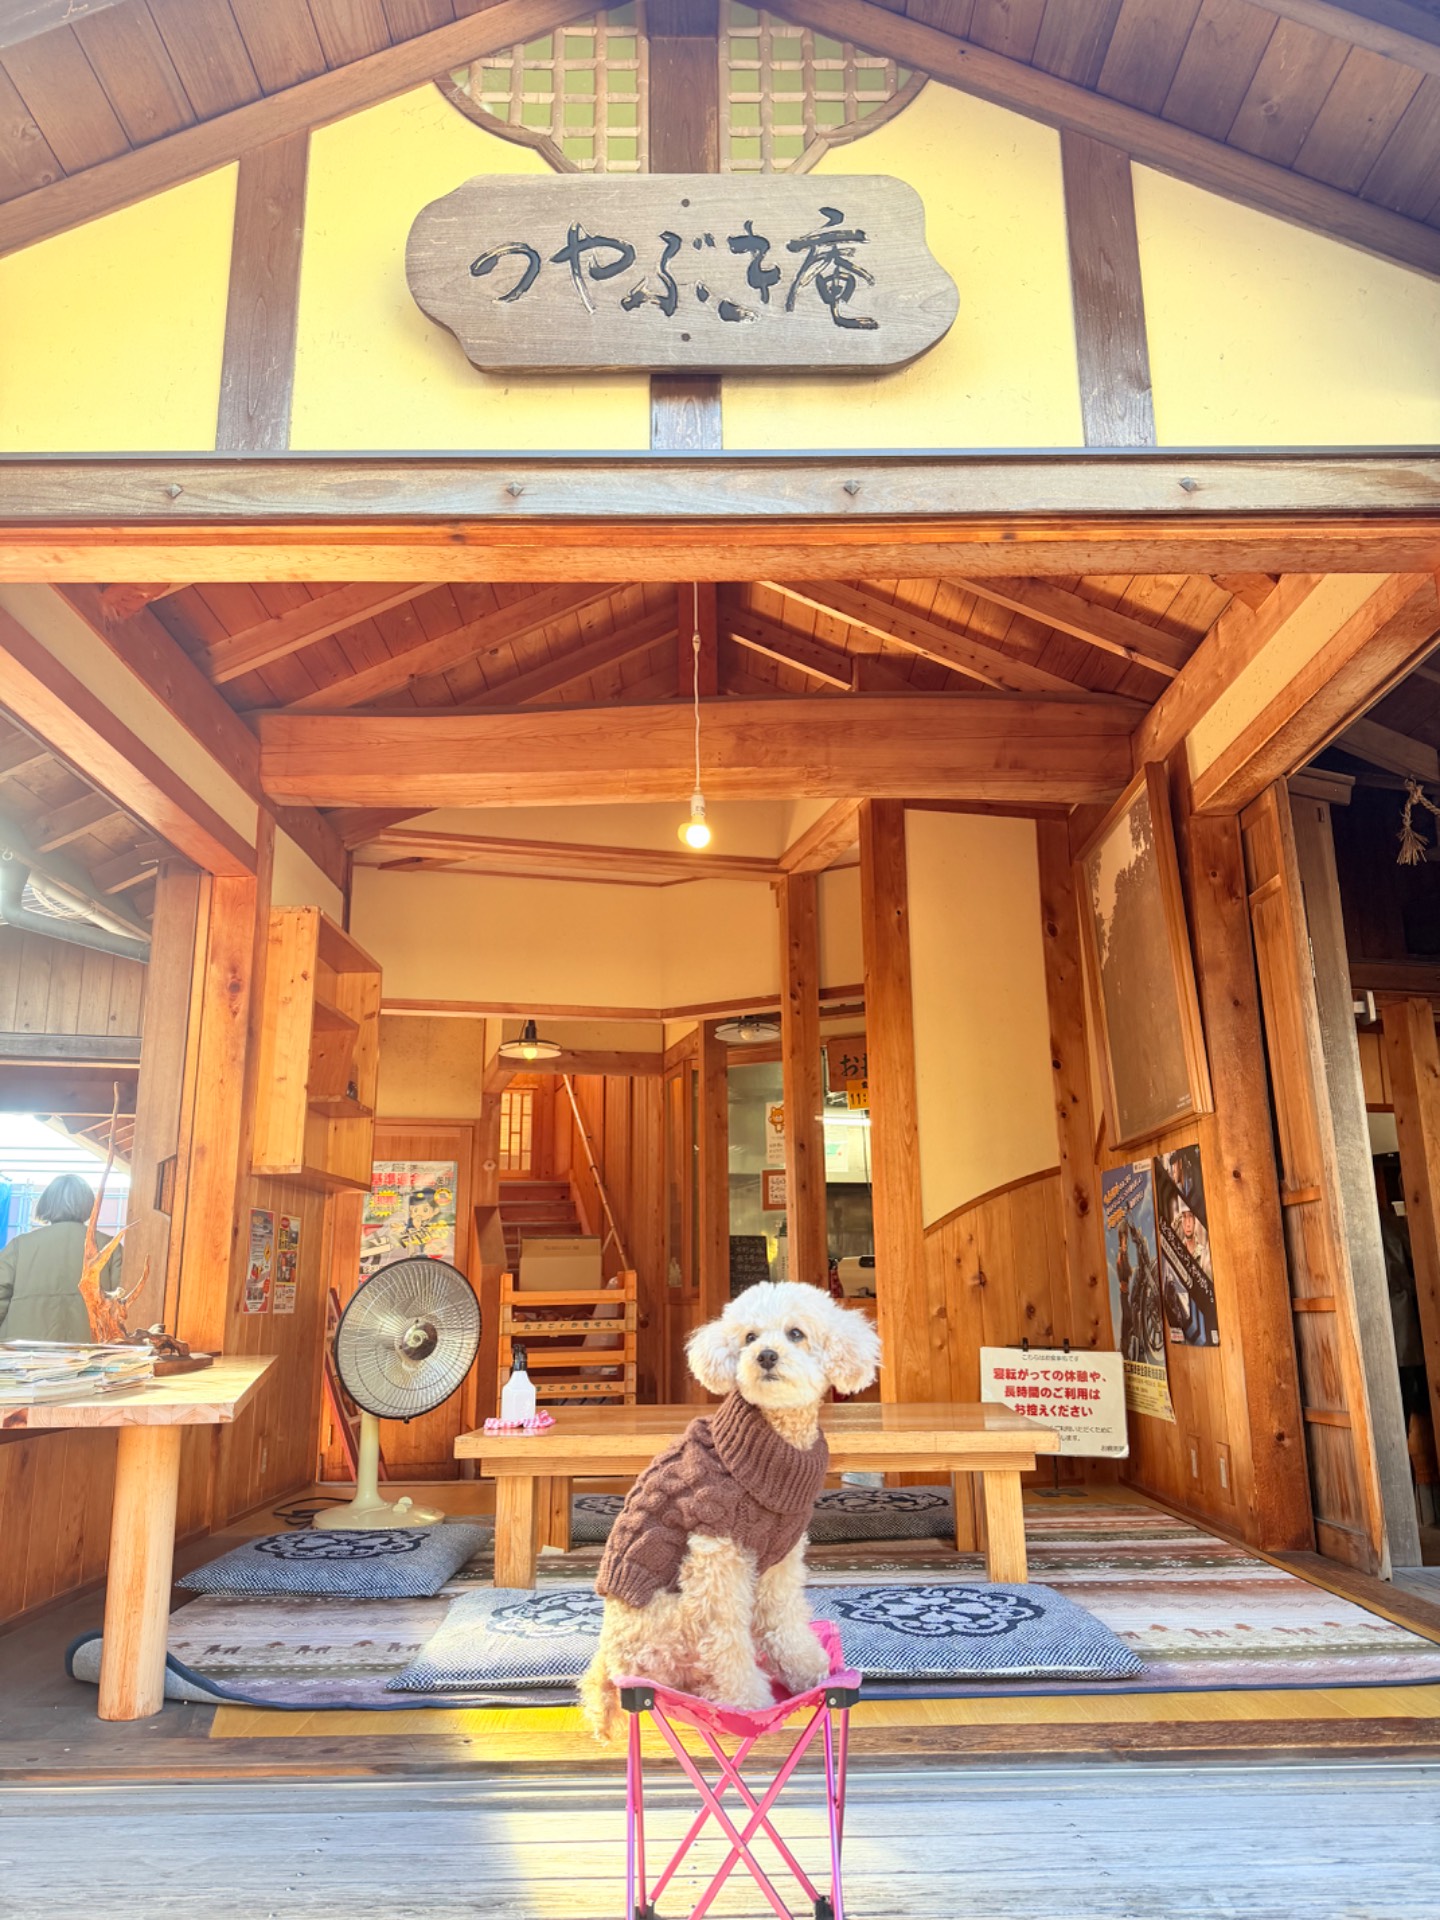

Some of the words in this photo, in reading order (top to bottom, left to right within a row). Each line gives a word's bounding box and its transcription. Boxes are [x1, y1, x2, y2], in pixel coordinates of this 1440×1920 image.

[470, 206, 879, 330] つやぶき庵
[993, 1367, 1107, 1383] 寝転がっての休憩や、
[1004, 1385, 1101, 1400] 長時間のご利用は
[1014, 1403, 1094, 1418] お控えください
